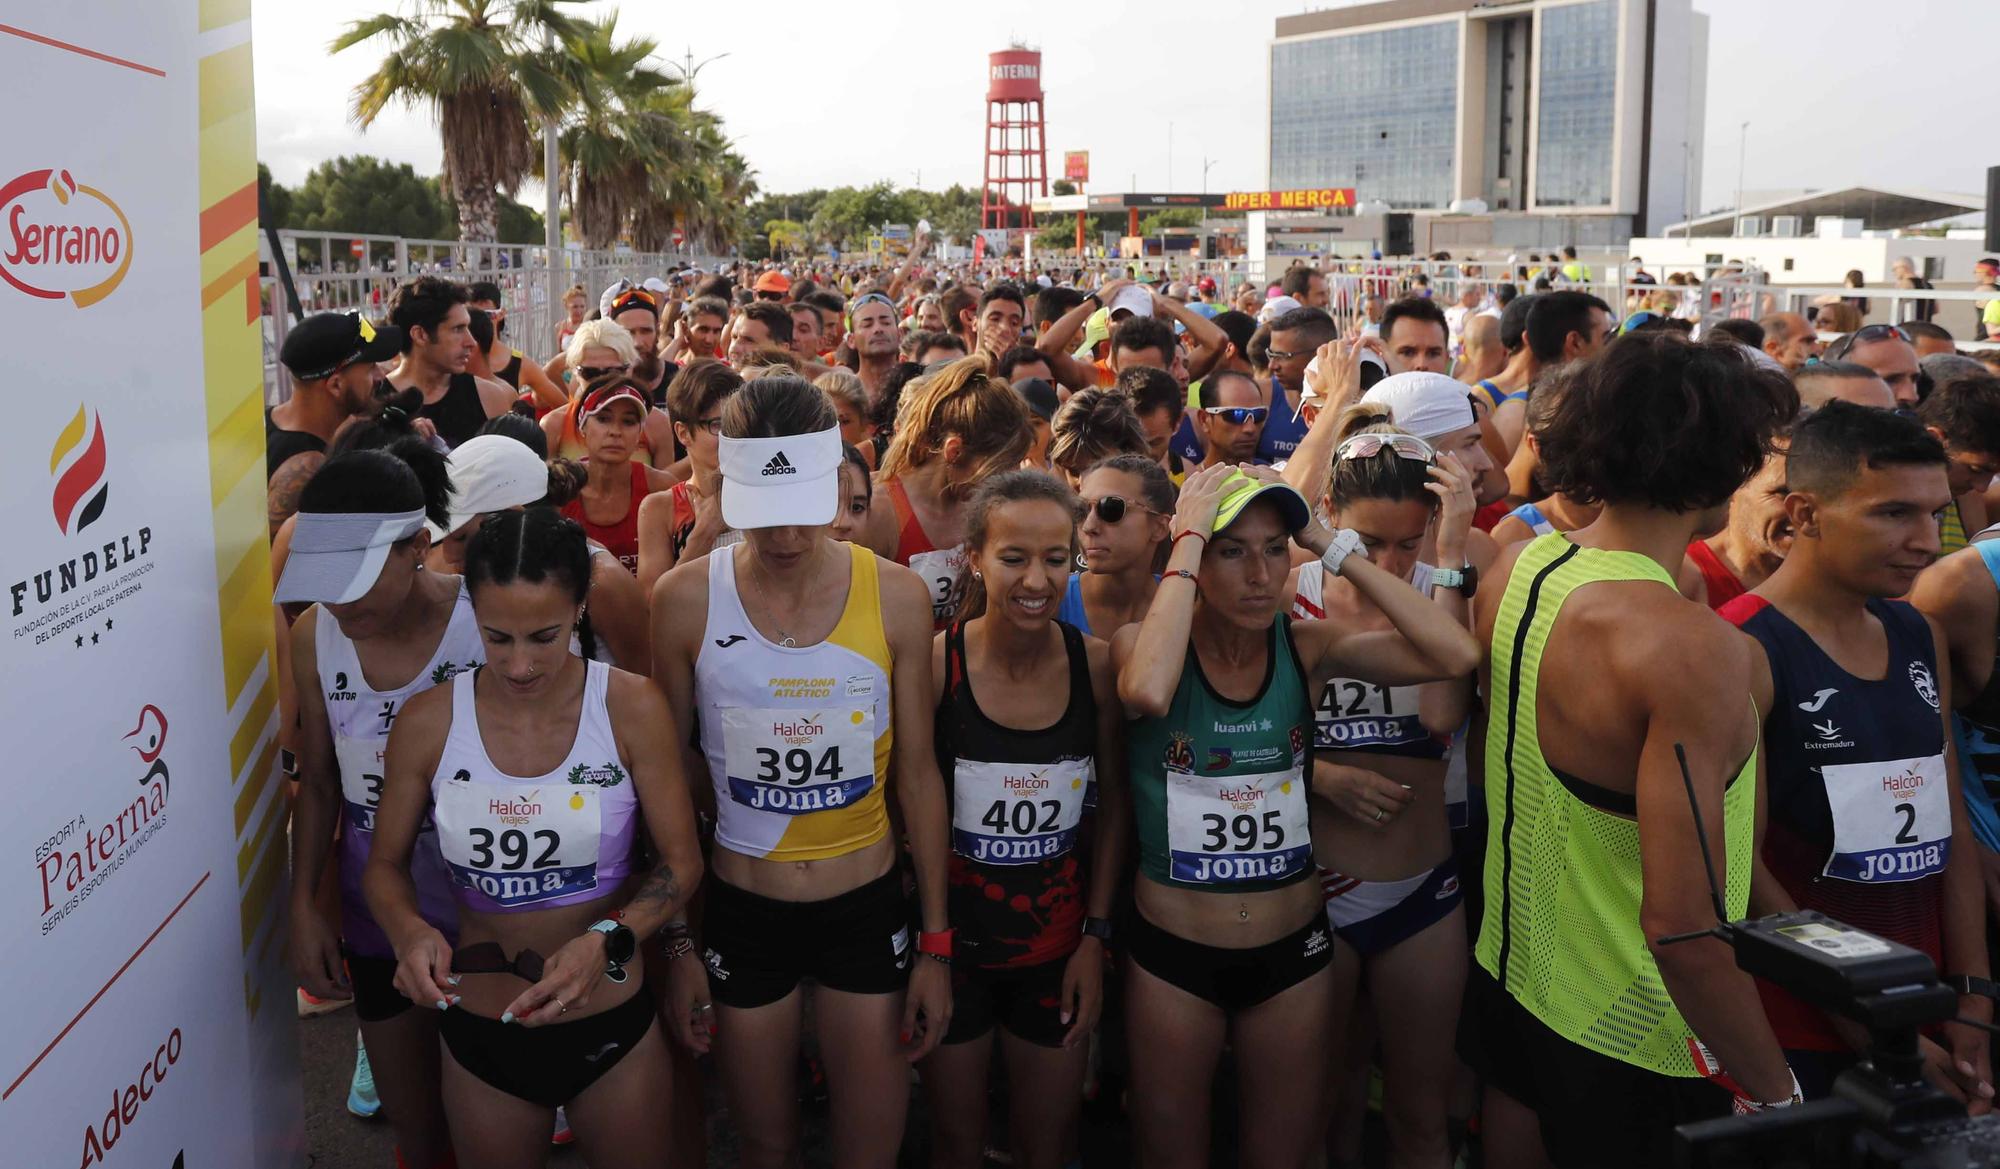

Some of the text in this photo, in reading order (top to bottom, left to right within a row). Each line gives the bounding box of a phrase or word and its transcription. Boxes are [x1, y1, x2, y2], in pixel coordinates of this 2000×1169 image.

[992, 64, 1038, 80] PATERNA
[1280, 190, 1346, 207] MERCA
[4, 204, 120, 265] Serrano
[761, 466, 797, 476] adidas
[10, 526, 151, 617] FUNDELP
[36, 582, 141, 645] DEL DEPORTE LOCAL DE PATERNA
[60, 603, 70, 616] DE
[71, 599, 80, 611] LA
[94, 584, 110, 600] PARA
[111, 579, 119, 591] LA
[768, 678, 837, 687] PAMPLONA
[1317, 682, 1393, 718] 421
[784, 736, 813, 747] viajes
[1214, 721, 1257, 733] luanvi
[1804, 740, 1855, 750] Extremadura
[755, 746, 843, 786] 394
[1013, 789, 1038, 798] viajes
[1231, 801, 1256, 812] viajes
[1893, 790, 1916, 800] viajes
[500, 816, 530, 827] viajes
[981, 800, 1062, 835] 402
[1202, 810, 1285, 852] 395
[1894, 803, 1918, 845] 2
[35, 814, 85, 863] ESPORT A
[37, 782, 165, 917] Paterna
[468, 828, 561, 870] 392
[41, 814, 167, 936] SERVEIS ESPORTIUS MUNICIPALS
[80, 1027, 182, 1169] Adecco
